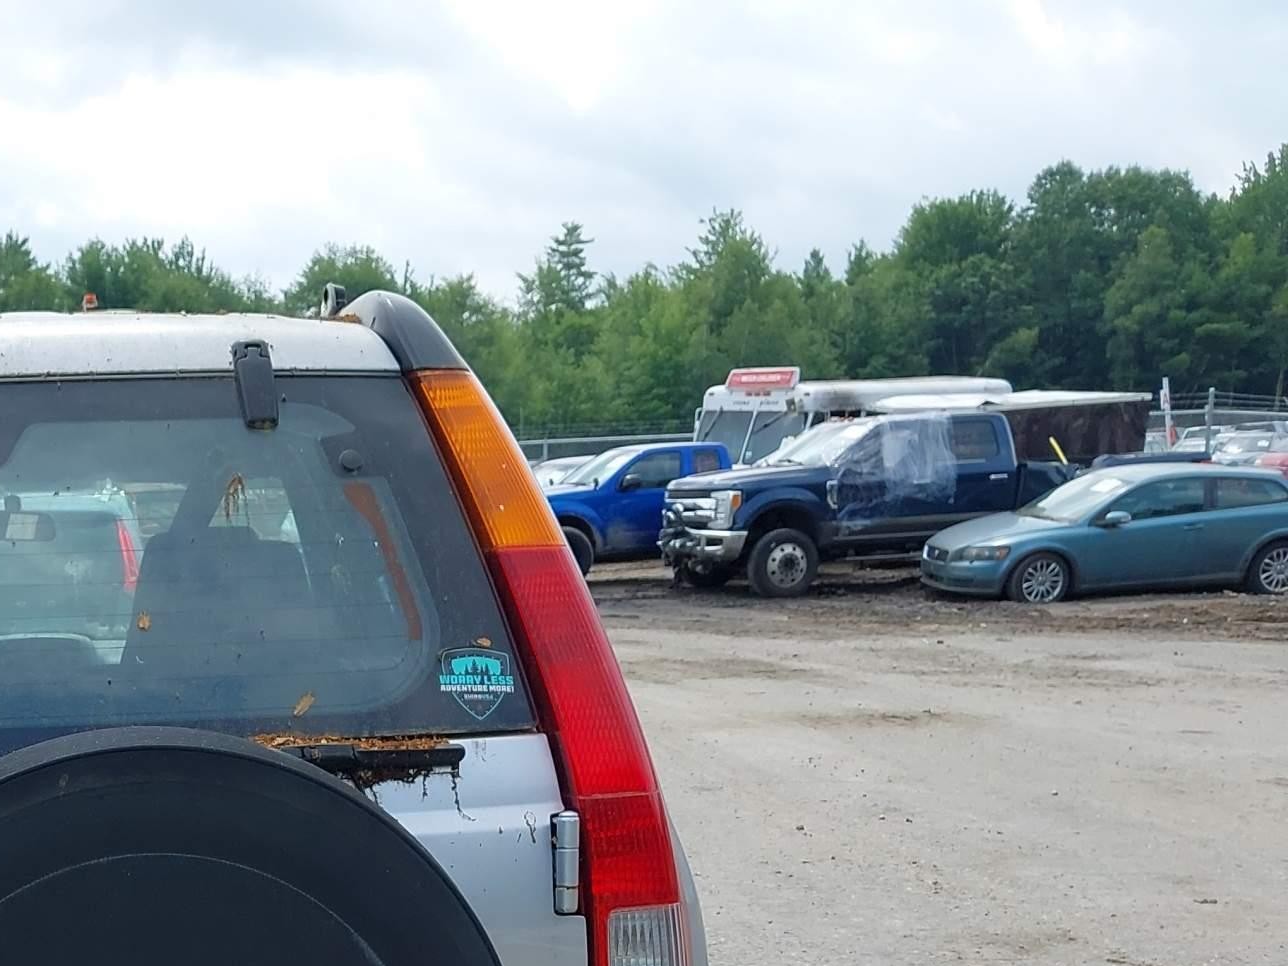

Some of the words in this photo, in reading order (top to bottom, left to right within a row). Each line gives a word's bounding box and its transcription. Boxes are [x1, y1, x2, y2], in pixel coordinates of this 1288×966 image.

[439, 674, 482, 685] WORRY
[483, 675, 514, 685] LESS
[440, 684, 489, 692] ADVENTURE
